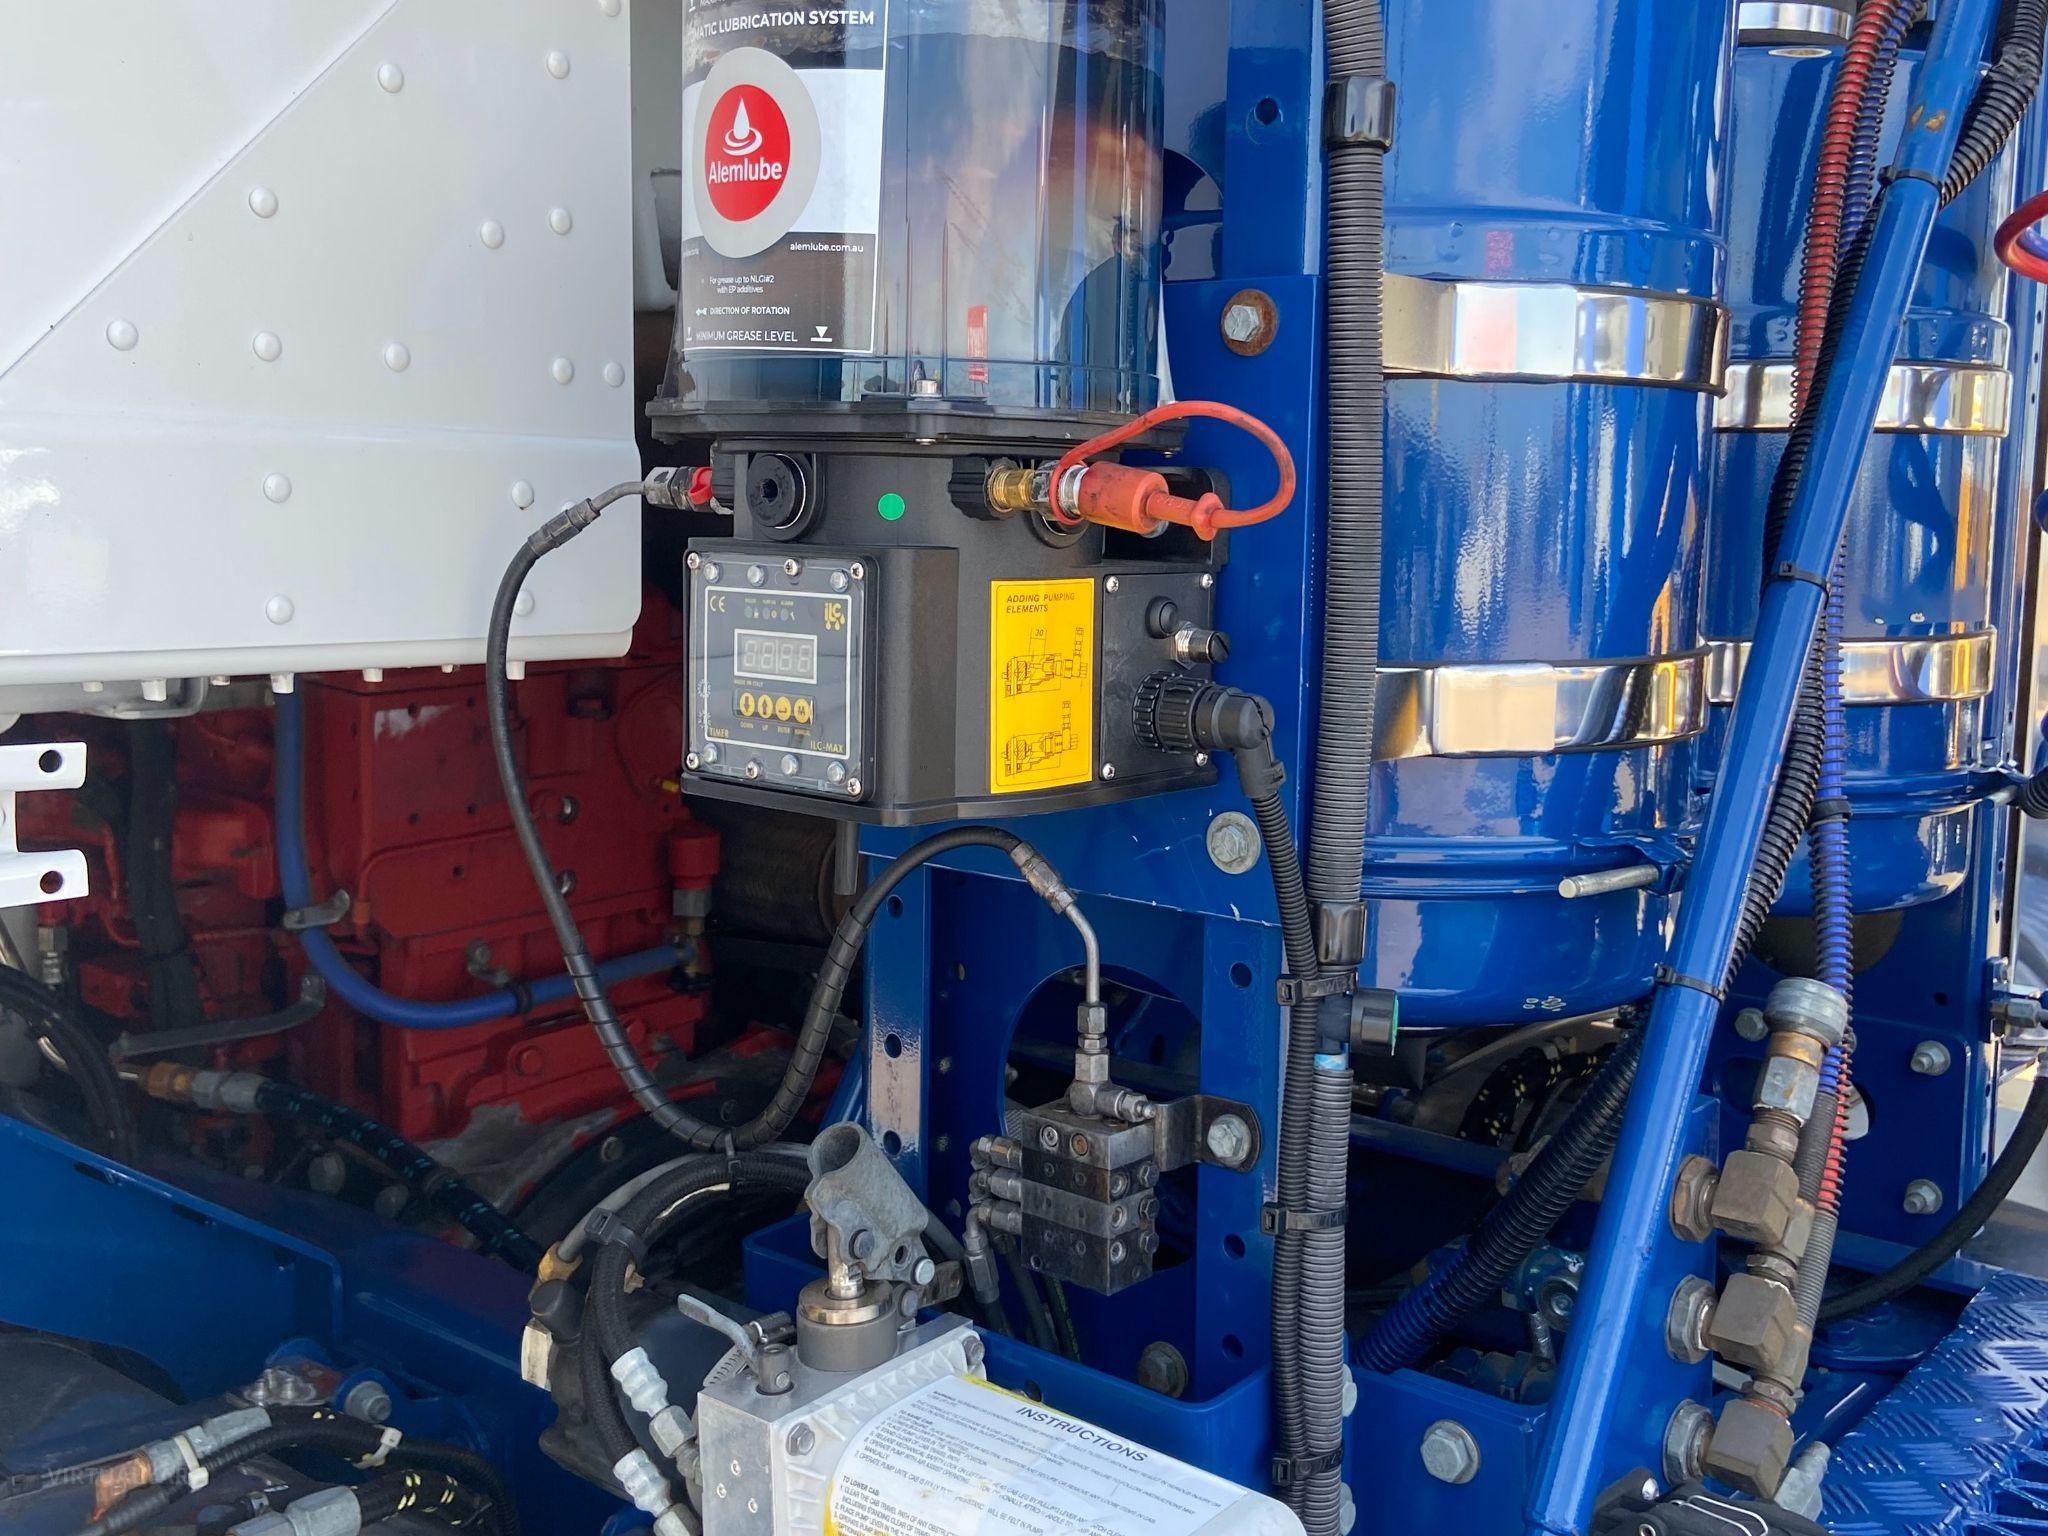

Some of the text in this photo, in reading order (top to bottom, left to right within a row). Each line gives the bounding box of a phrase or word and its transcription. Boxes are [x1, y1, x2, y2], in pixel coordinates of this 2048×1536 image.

[719, 12, 804, 34] LUBRICATION
[809, 10, 874, 25] SYSTEM
[709, 157, 783, 184] Alemlube
[790, 242, 864, 253] alemlube.com.au
[735, 276, 742, 284] up
[743, 275, 749, 283] to
[710, 306, 790, 315] DIRECTION OF ROTATION
[726, 331, 762, 341] GREASE
[764, 331, 798, 342] LEVEL
[1007, 592, 1075, 603] ADDING PUMPING
[1006, 603, 1048, 613] ELEMENTS
[710, 727, 729, 738] TIMER
[810, 740, 844, 754] ILC-MAX
[1016, 1406, 1149, 1462] INSTRUCTIONS
